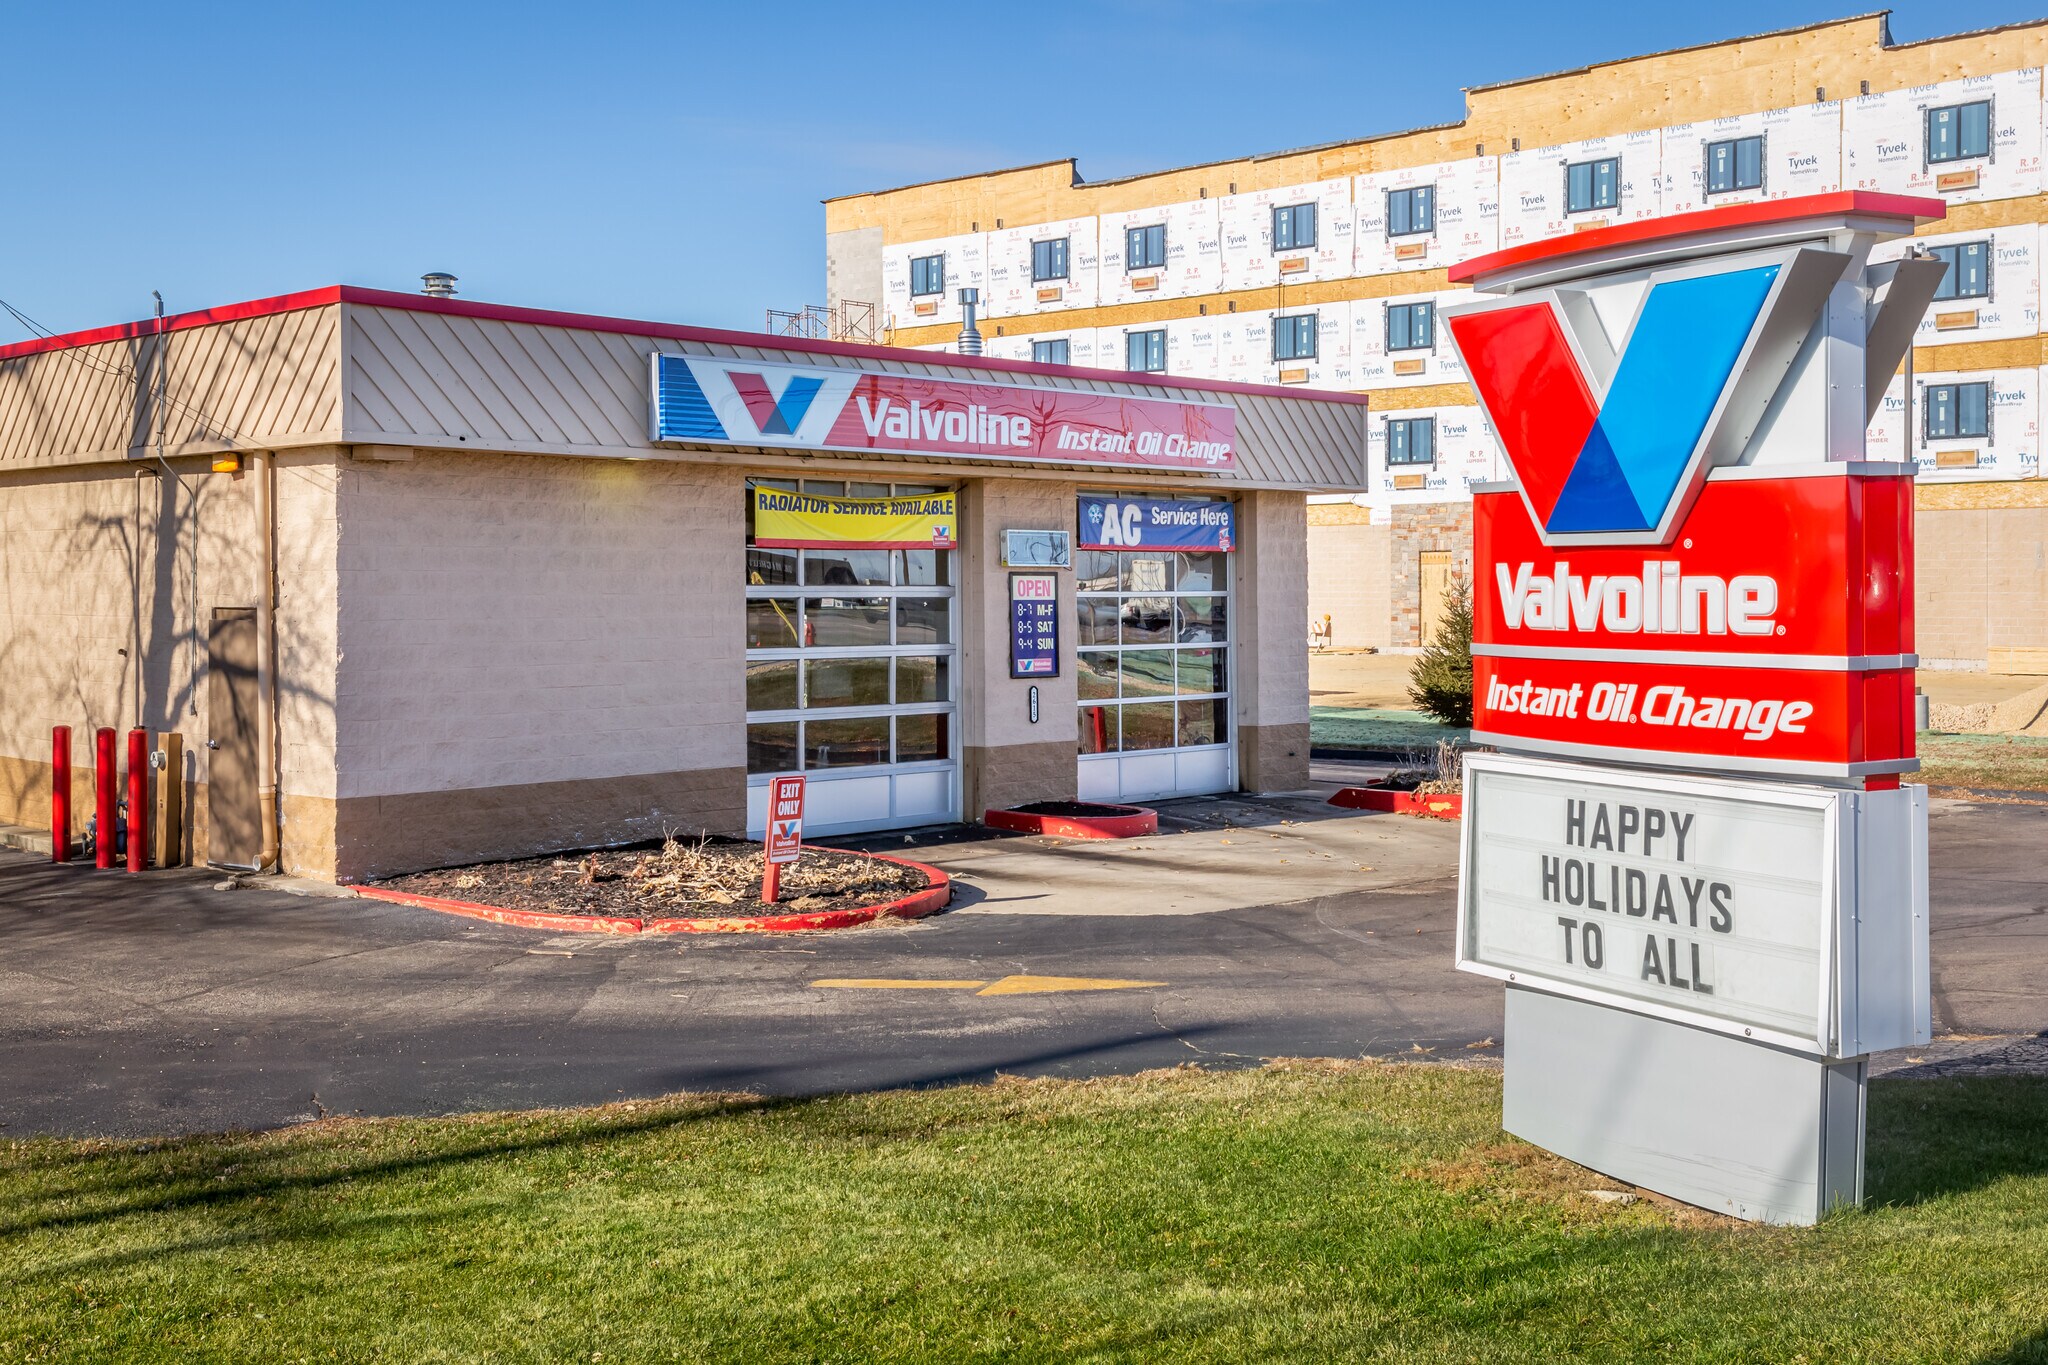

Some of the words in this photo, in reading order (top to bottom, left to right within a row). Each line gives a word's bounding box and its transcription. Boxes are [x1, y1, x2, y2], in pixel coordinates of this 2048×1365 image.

[1877, 142, 1906, 156] Tyvek
[1789, 155, 1817, 169] Tyvek
[1878, 155, 1908, 163] HomeWrap
[1907, 180, 1934, 188] LUMBER
[1521, 194, 1544, 207] Tyvek
[1438, 206, 1462, 219] Tyvek
[1479, 203, 1498, 213] Tyve
[1334, 222, 1351, 232] Tyve
[1361, 217, 1382, 229] Tyvek
[1198, 240, 1217, 250] Tyvek
[1227, 234, 1247, 245] Tyvek
[1105, 252, 1120, 263] yvek
[1997, 246, 2028, 260] Tyvek
[991, 267, 1007, 276] Tyvek
[1192, 332, 1211, 342] Tyvek
[1246, 327, 1266, 337] Tyvek
[1073, 344, 1091, 352] Tyvek
[1362, 366, 1384, 377] Tyvek
[1263, 375, 1280, 384] Tyve
[1992, 391, 2025, 402] Tyvek
[857, 396, 1032, 447] Valvoline
[1443, 424, 1467, 435] Tyvek
[1057, 424, 1132, 452] Instant
[1138, 430, 1163, 455] Oil
[1165, 434, 1230, 463] Change
[759, 493, 829, 514] RADIATOR
[833, 501, 887, 515] SERVICE
[890, 499, 953, 516] AVAILABLE
[1152, 506, 1197, 526] Service
[1200, 508, 1228, 526] Here
[1100, 503, 1142, 547] AC
[1018, 579, 1051, 597] OPEN
[1018, 603, 1033, 616] 8-7
[1037, 604, 1053, 617] M-F
[1018, 620, 1033, 634] 8-5
[1037, 621, 1053, 633] SAT
[1037, 638, 1053, 651] SUN
[1486, 675, 1582, 719] Instant
[1640, 686, 1813, 741] Change
[780, 783, 801, 799] EXIT
[777, 800, 801, 817] ONLY
[1566, 799, 1694, 862] HAPPY
[1542, 855, 1732, 934] HOLIDAYS
[1558, 916, 1604, 970] TO
[1641, 934, 1713, 995] ALL
